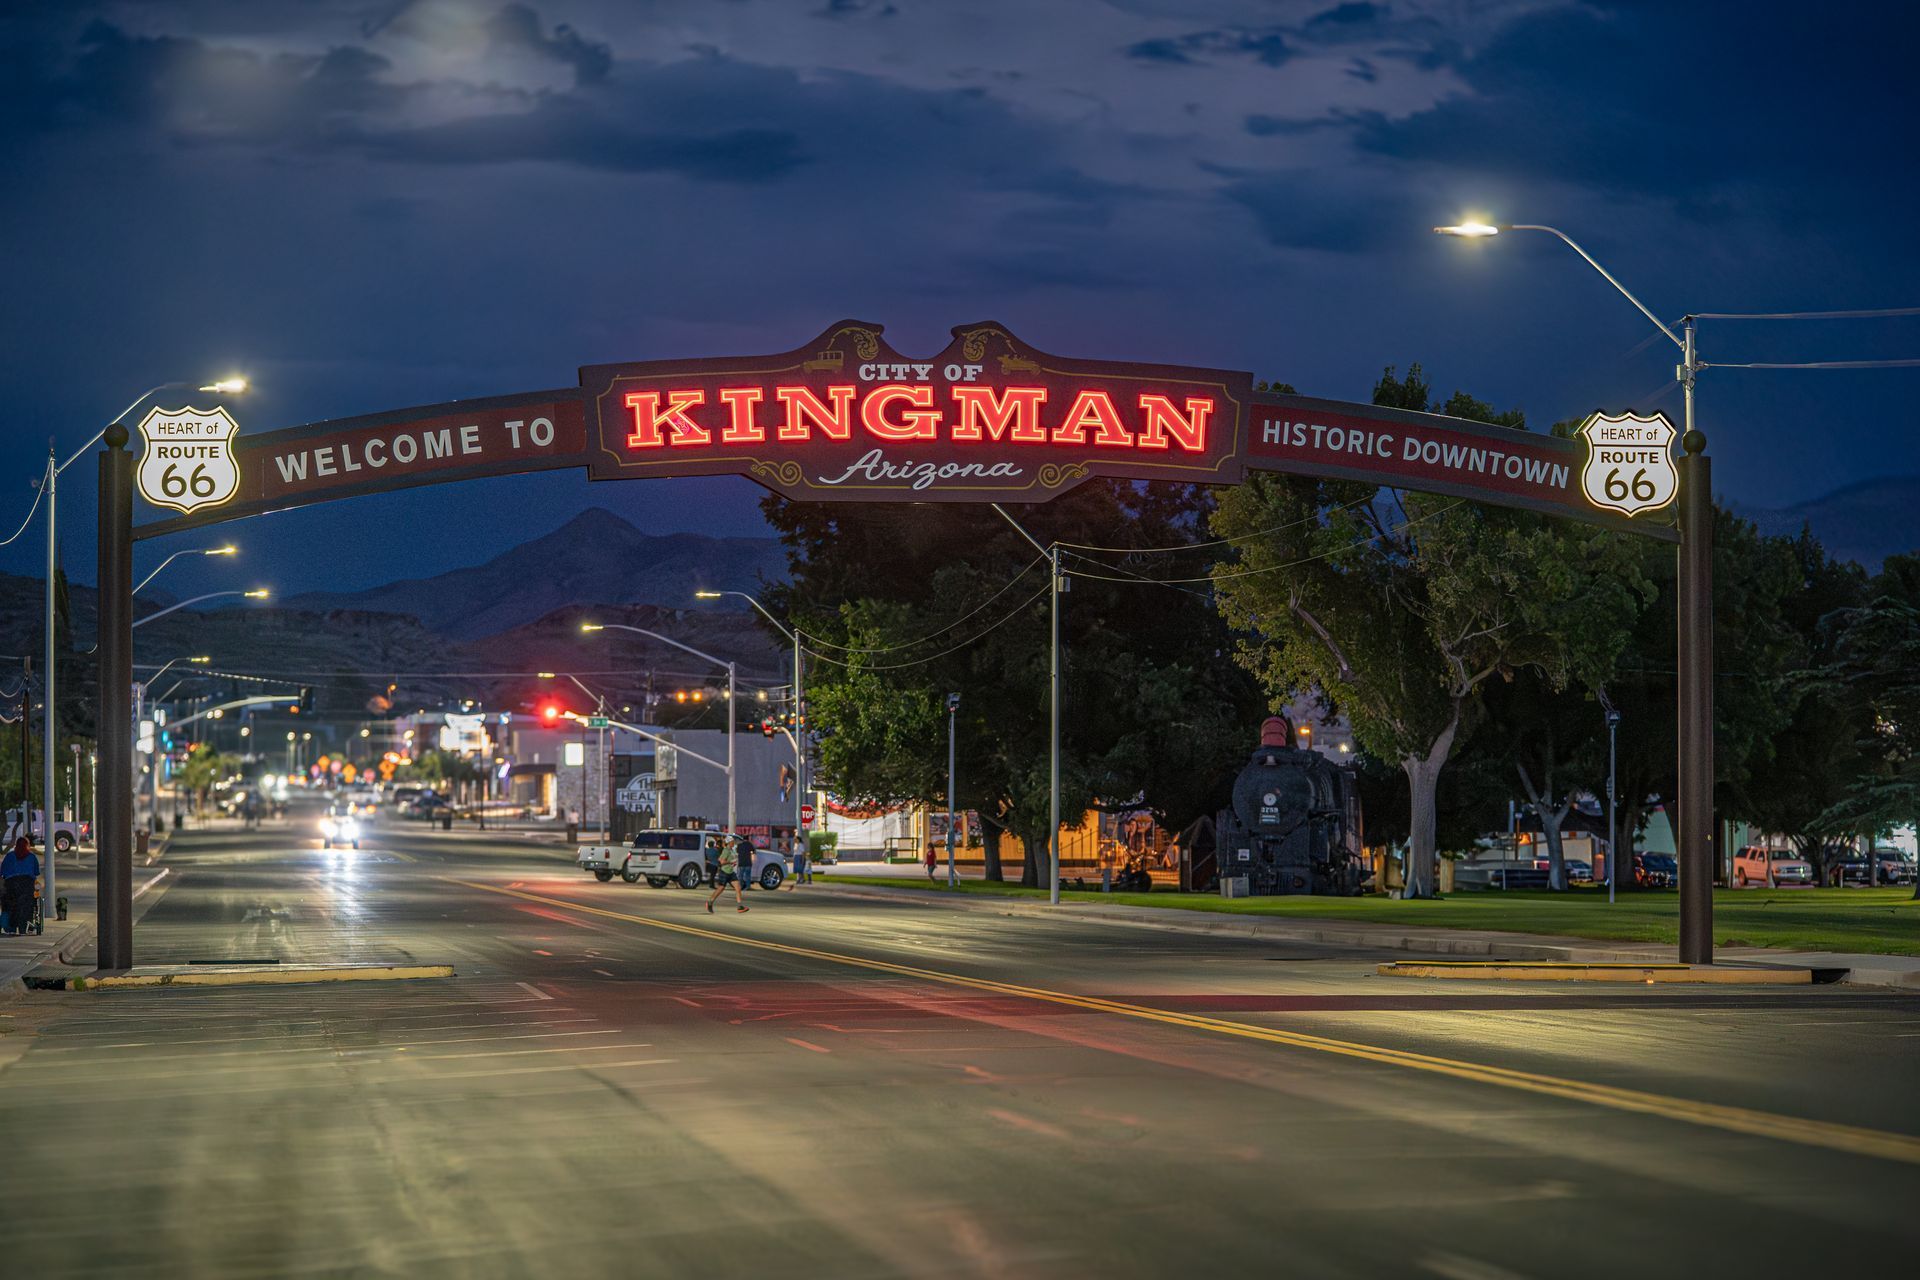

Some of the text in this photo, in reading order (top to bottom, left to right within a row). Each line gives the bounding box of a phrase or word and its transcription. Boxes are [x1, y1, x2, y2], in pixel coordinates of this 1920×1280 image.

[858, 363, 983, 382] CITY OF
[625, 385, 1213, 452] KINGMAN
[158, 422, 219, 435] HEART of
[1601, 428, 1658, 441] HEART of
[157, 446, 220, 459] ROUTE
[275, 417, 554, 483] WELCOME TO
[1263, 419, 1569, 489] HISTORIC DOWNTOWN
[1600, 451, 1659, 464] ROUTE
[819, 449, 1022, 490] Arizona
[161, 462, 216, 498] 66
[1604, 467, 1656, 502] 66
[637, 777, 656, 790] TH
[621, 792, 656, 801] HEAL
[635, 803, 656, 815] BA
[802, 810, 815, 819] TOP
[723, 825, 769, 835] HRITAGE
